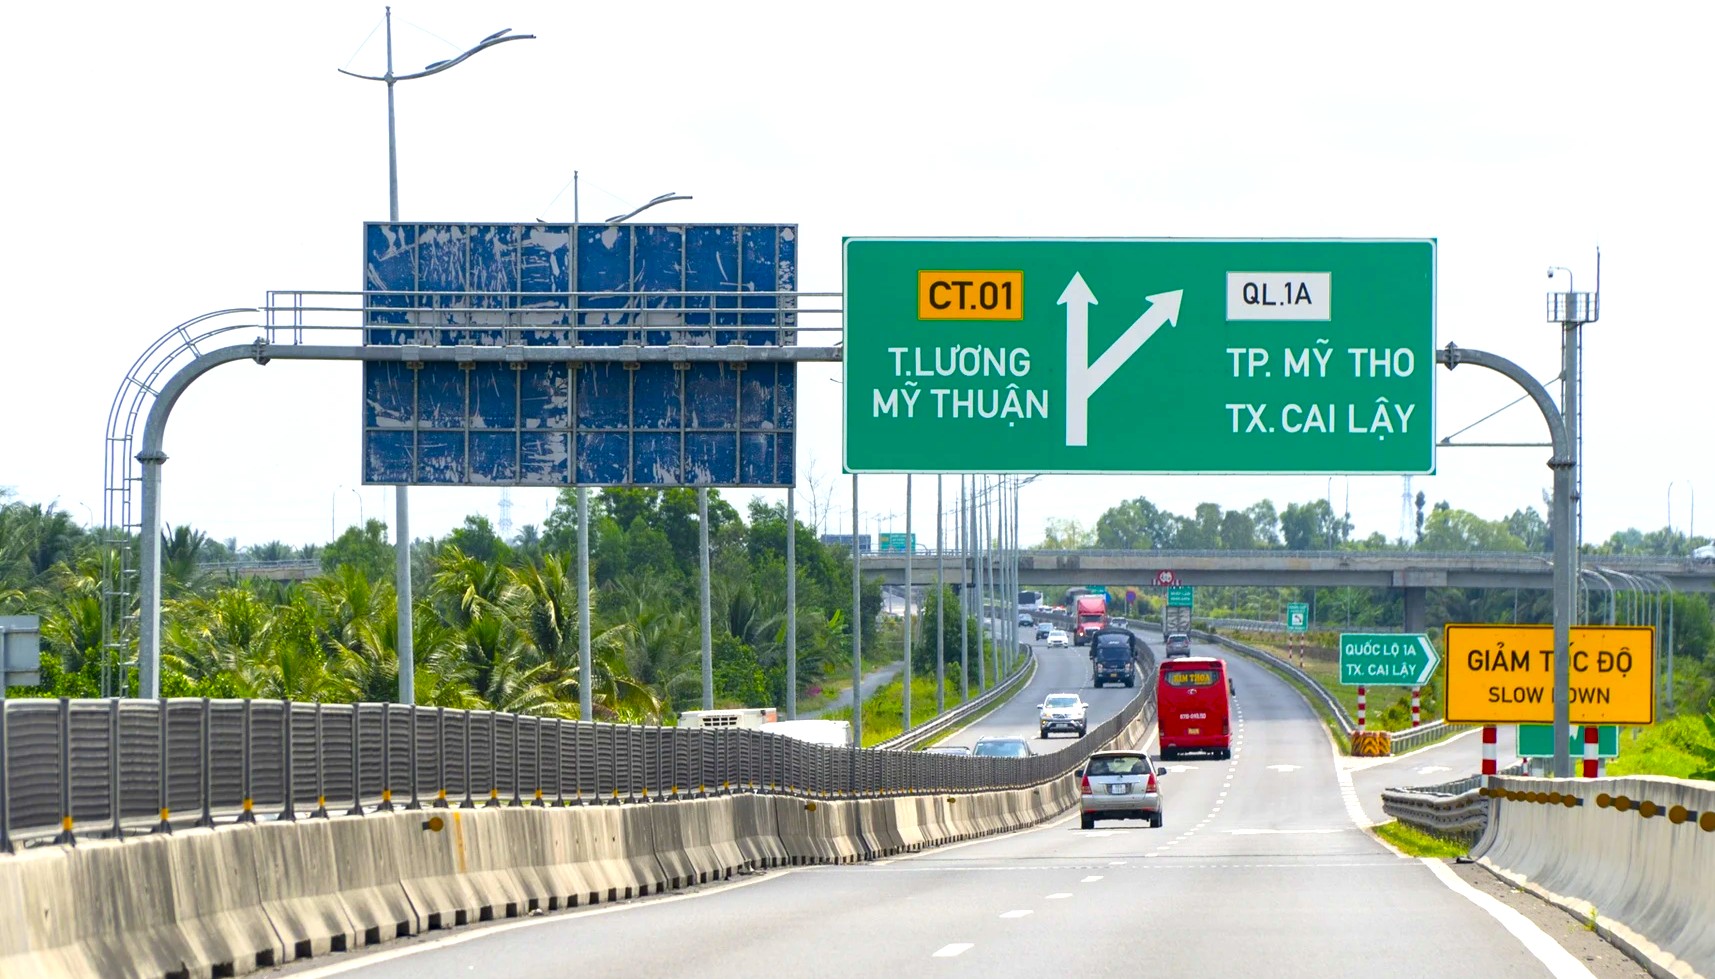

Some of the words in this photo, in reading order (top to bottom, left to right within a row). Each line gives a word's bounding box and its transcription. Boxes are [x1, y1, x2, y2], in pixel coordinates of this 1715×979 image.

[928, 280, 1013, 311] CT.01
[1242, 281, 1312, 306] QL.1A
[888, 344, 1031, 377] T.LƯƠNG
[1226, 347, 1271, 377] TP.
[1284, 338, 1333, 377] MỸ
[1347, 347, 1415, 378] THO
[873, 380, 921, 418] MỸ
[930, 383, 1049, 427] THUẬN
[1348, 396, 1415, 441] LẬY
[1345, 640, 1380, 656] QUỐC
[1383, 642, 1400, 658] LỘ
[1403, 644, 1417, 656] 1A
[1467, 641, 1530, 672] GIẢM
[1539, 641, 1589, 673] TC
[1596, 646, 1633, 678] ĐỘ
[1345, 663, 1365, 676] TX.
[1368, 663, 1389, 676] CAI
[1392, 661, 1417, 679] LẬY
[1488, 686, 1545, 704] SLOW
[1551, 686, 1610, 704] OWN
